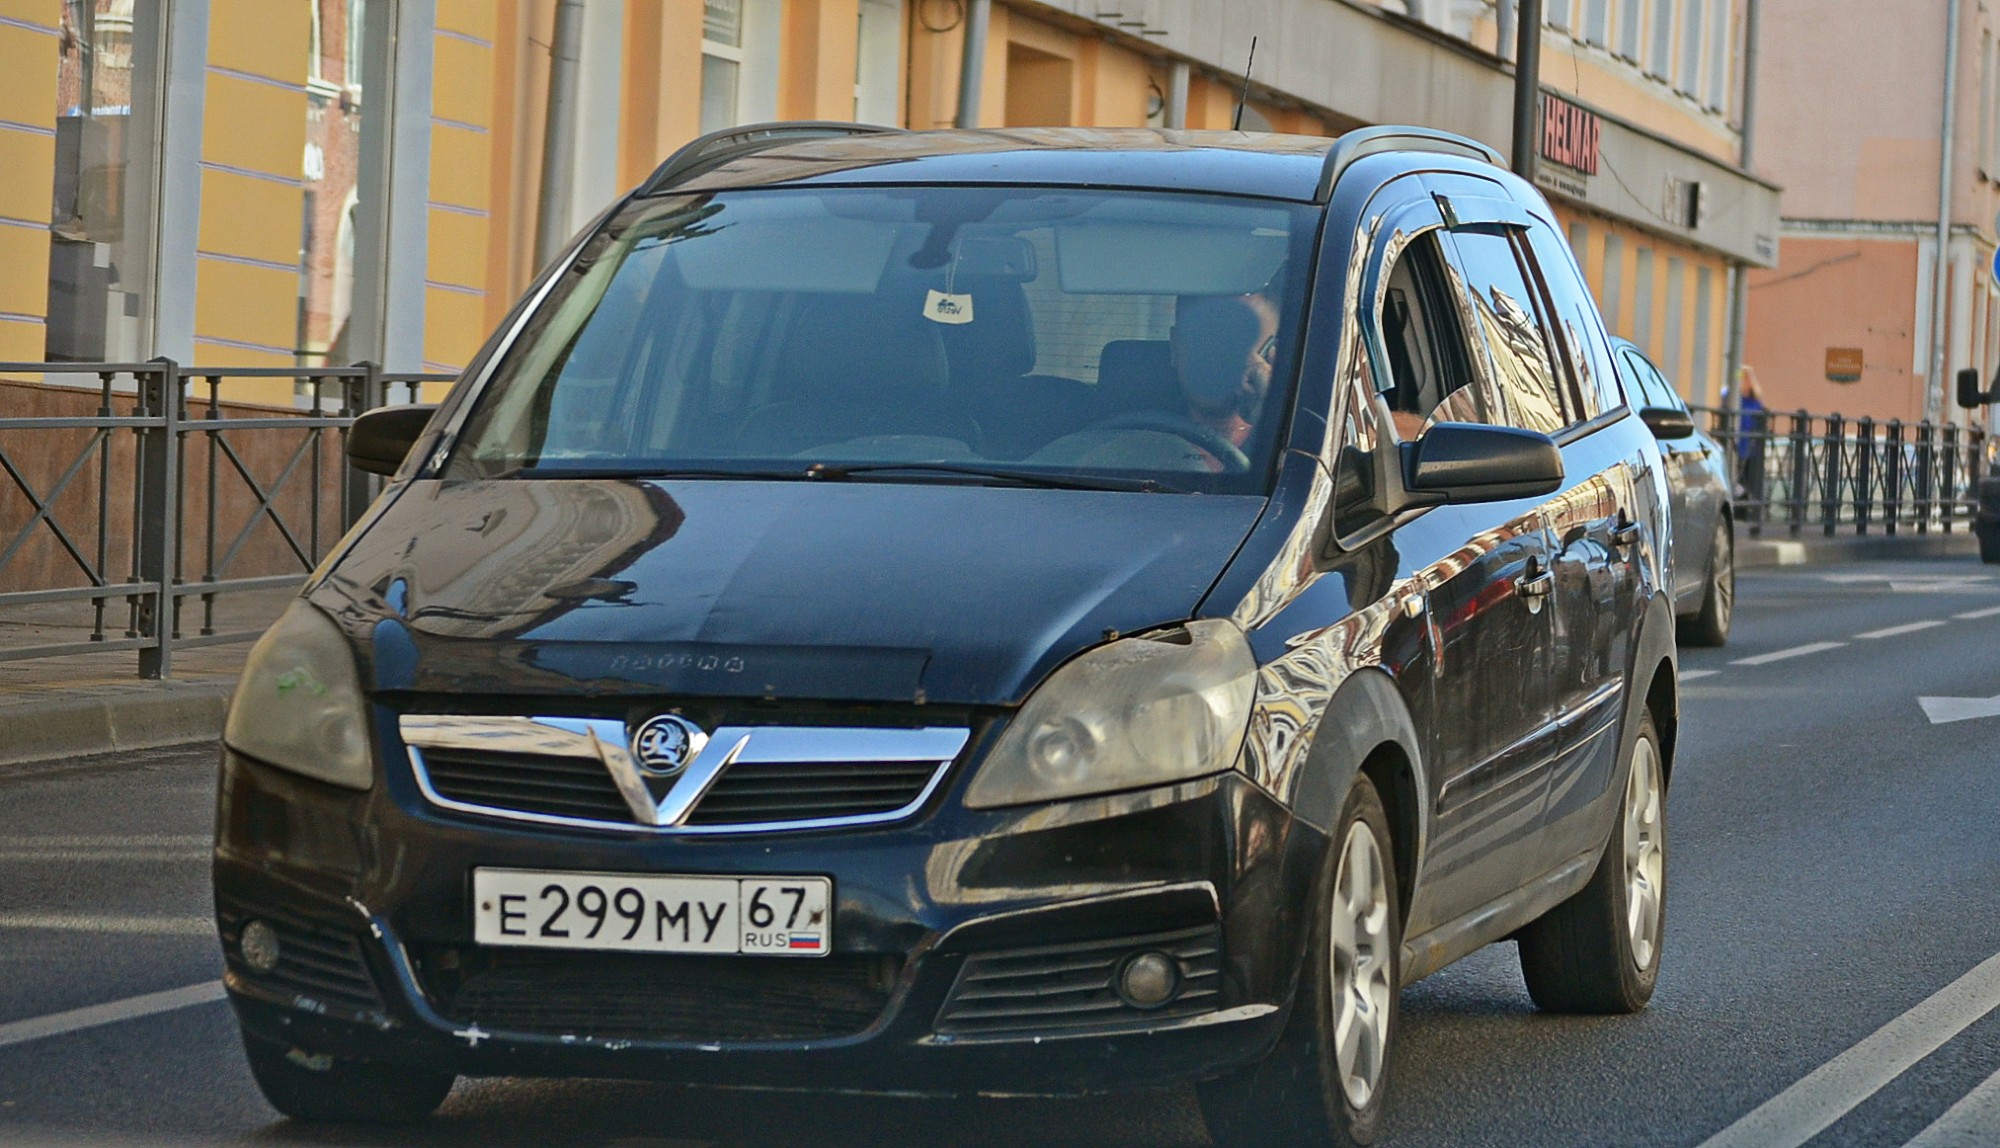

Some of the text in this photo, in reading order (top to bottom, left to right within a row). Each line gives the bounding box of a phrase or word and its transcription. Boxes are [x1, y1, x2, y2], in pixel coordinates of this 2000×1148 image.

[1544, 93, 1600, 176] HELMAR
[748, 887, 806, 930] 67
[745, 932, 787, 948] RUS
